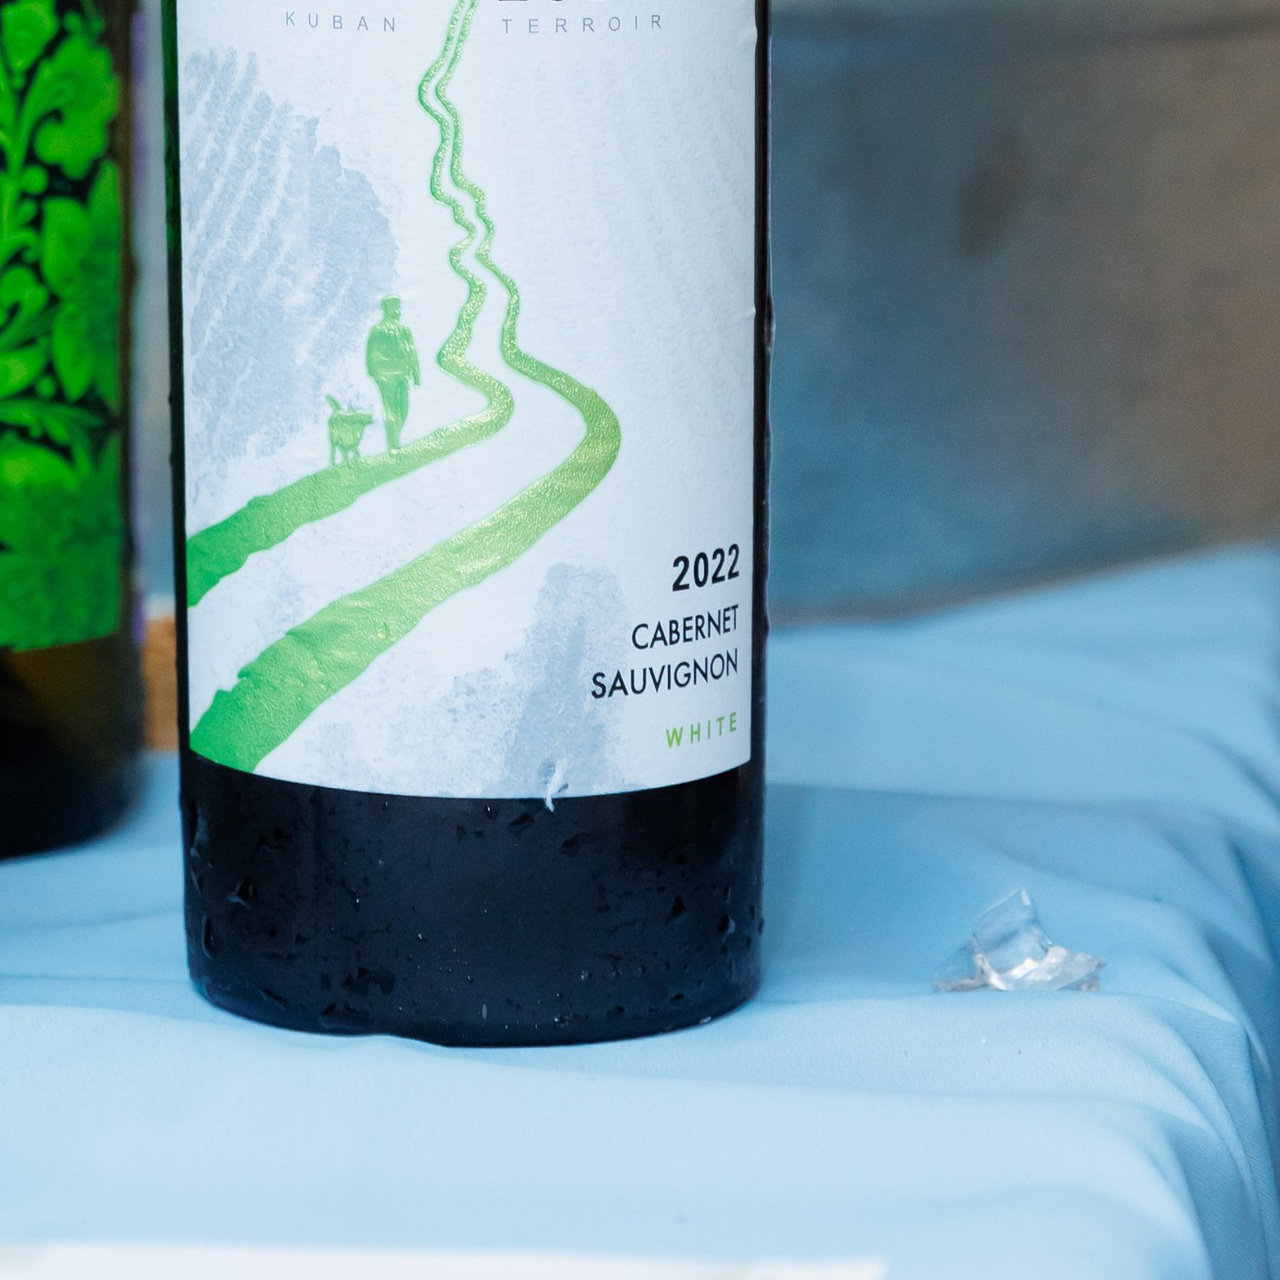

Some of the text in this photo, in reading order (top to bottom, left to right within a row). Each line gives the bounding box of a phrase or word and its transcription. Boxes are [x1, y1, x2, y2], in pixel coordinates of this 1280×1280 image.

[285, 10, 663, 35] KUBAN TERROIR
[671, 542, 740, 592] 2022
[631, 603, 740, 650] CABERNET
[590, 647, 739, 700] SAUVIGNON
[665, 711, 738, 749] WHITE
